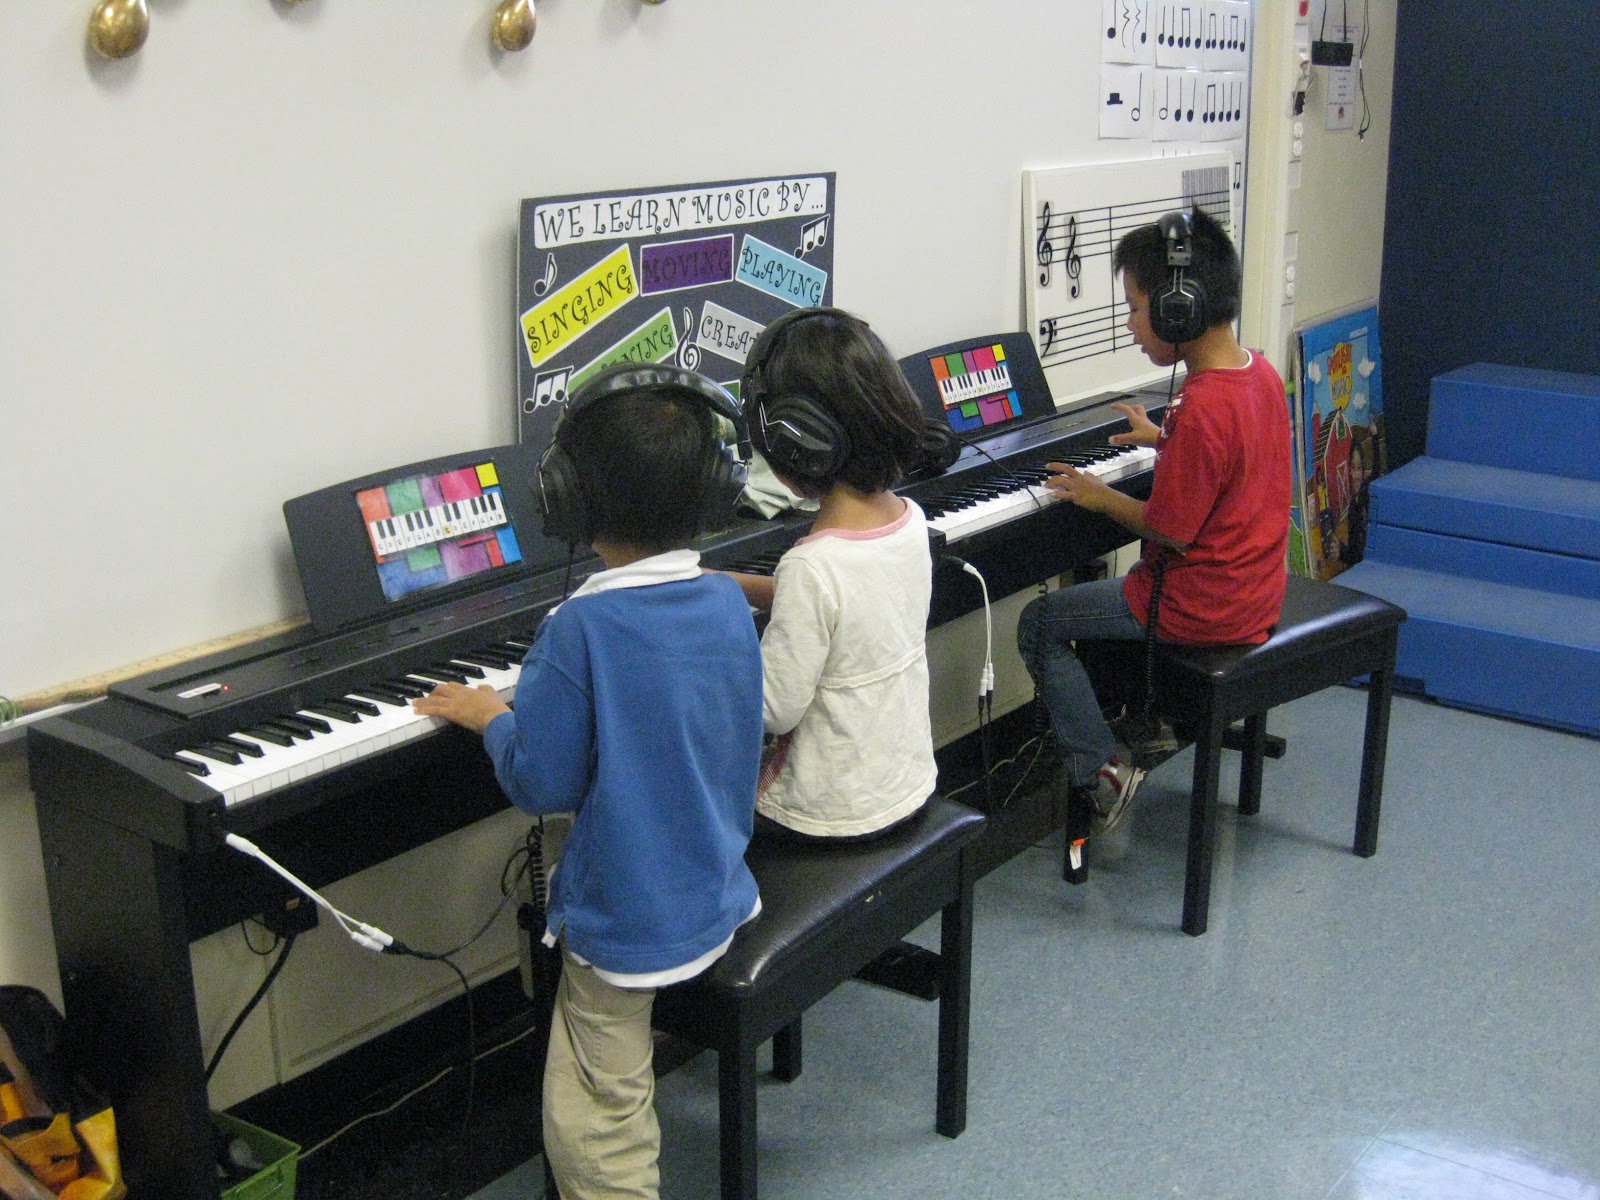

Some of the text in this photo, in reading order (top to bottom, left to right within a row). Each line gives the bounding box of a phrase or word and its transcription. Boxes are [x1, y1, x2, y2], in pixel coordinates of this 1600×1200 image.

[537, 204, 584, 242] WE
[593, 196, 686, 235] LEARN
[692, 187, 769, 224] MUSIC
[641, 247, 732, 284] MOVING
[740, 245, 821, 308] PLAYING
[527, 264, 632, 354] SINGING
